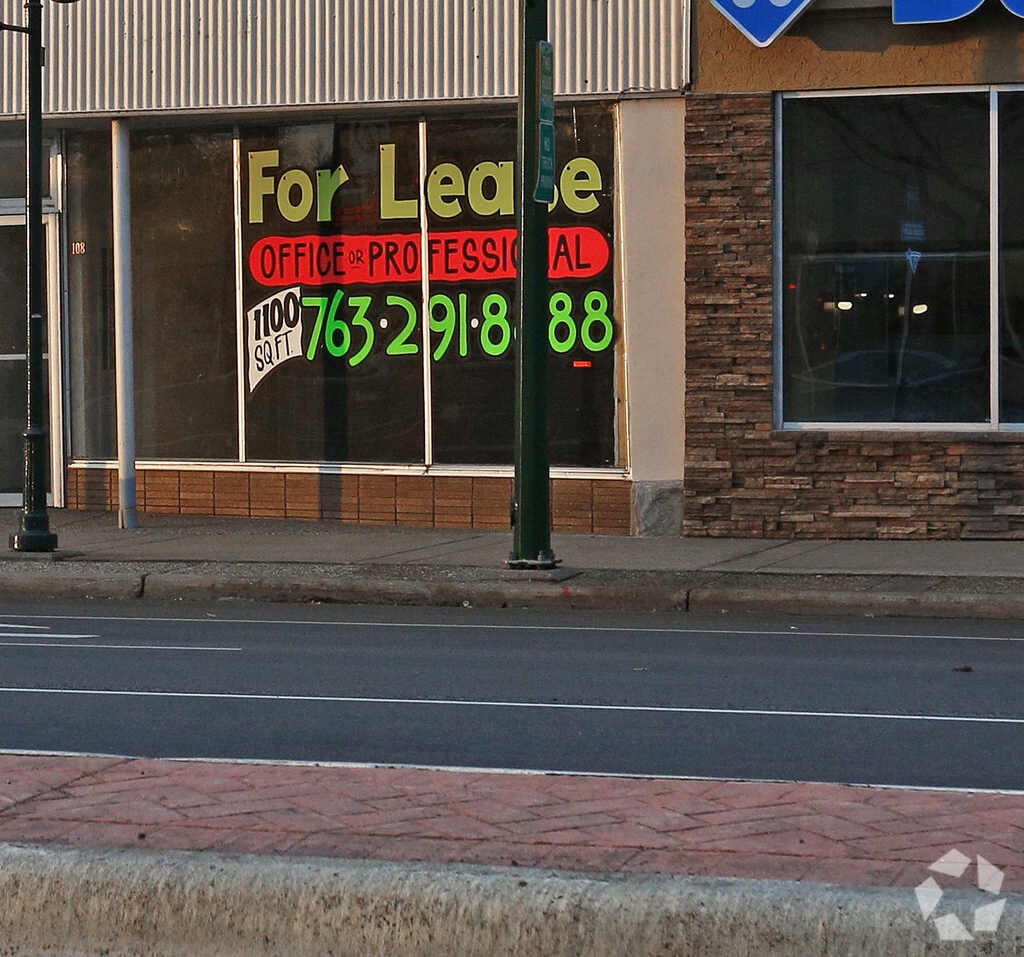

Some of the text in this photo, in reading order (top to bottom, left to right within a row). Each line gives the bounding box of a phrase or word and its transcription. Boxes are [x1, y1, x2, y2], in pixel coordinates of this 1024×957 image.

[248, 149, 350, 223] For
[379, 143, 602, 220] Leae
[72, 242, 86, 255] 108
[260, 233, 592, 279] OFFICE OR PROFESSIAL
[254, 292, 300, 341] 1100
